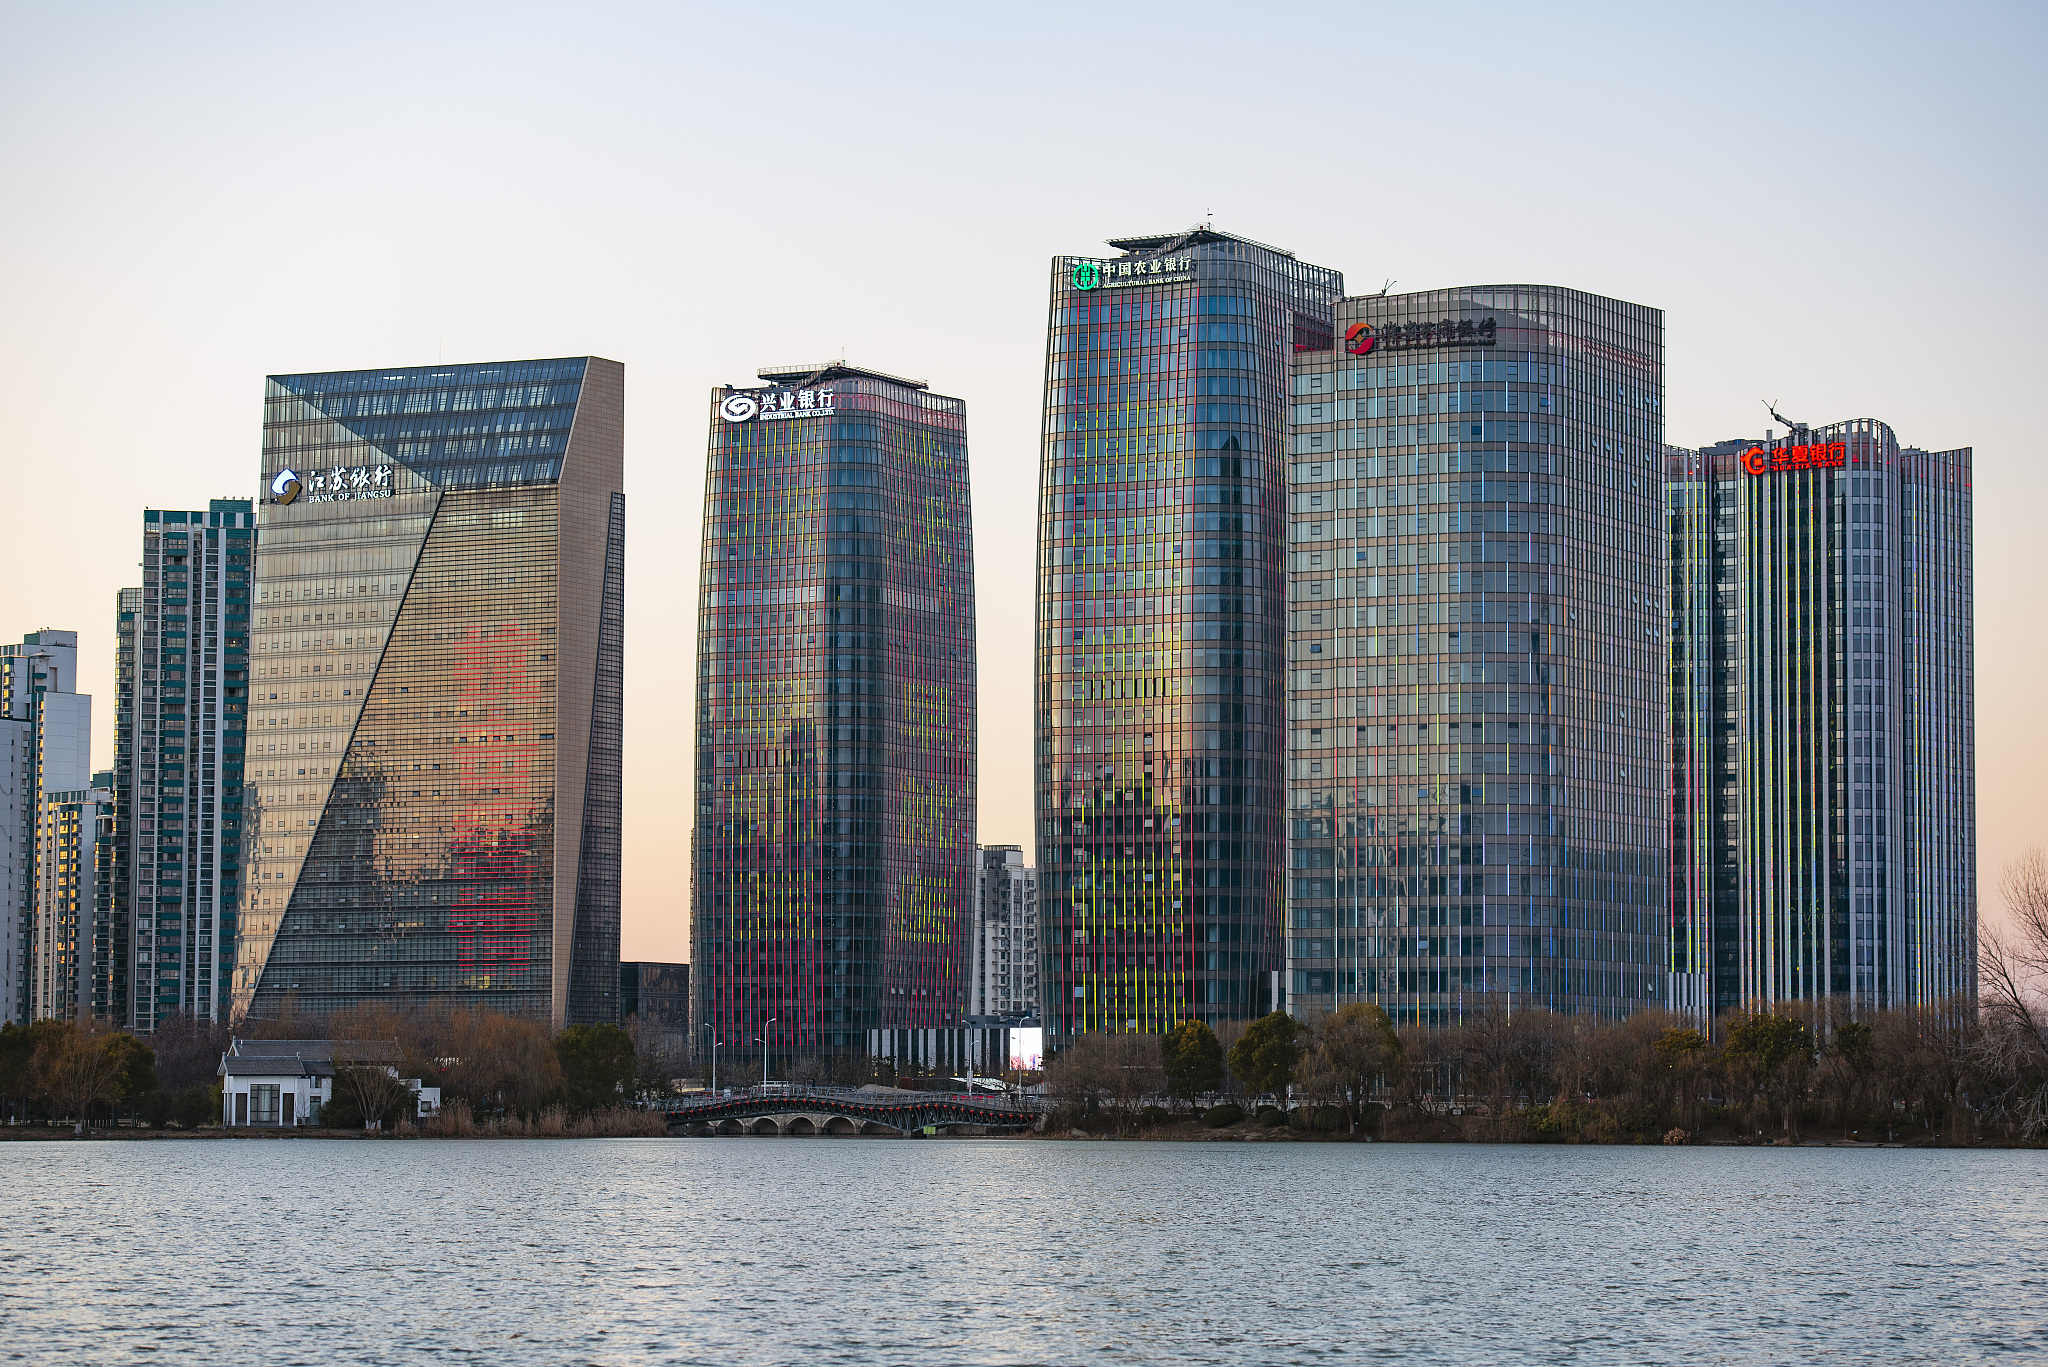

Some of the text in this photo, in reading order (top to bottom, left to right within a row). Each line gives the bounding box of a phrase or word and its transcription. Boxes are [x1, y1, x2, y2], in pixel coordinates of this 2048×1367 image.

[1102, 256, 1192, 278] 中国农业银行
[1102, 279, 1147, 289] AGRICULTURAL
[1148, 277, 1165, 285] BANK
[759, 388, 834, 412] 兴业银行
[759, 412, 794, 421] INDUSTRIAL
[1771, 442, 1846, 464] 华夏银行
[1817, 460, 1844, 468] BANK
[308, 464, 392, 492] 江苏银行
[308, 489, 392, 503] BANK OF JIANGSU
